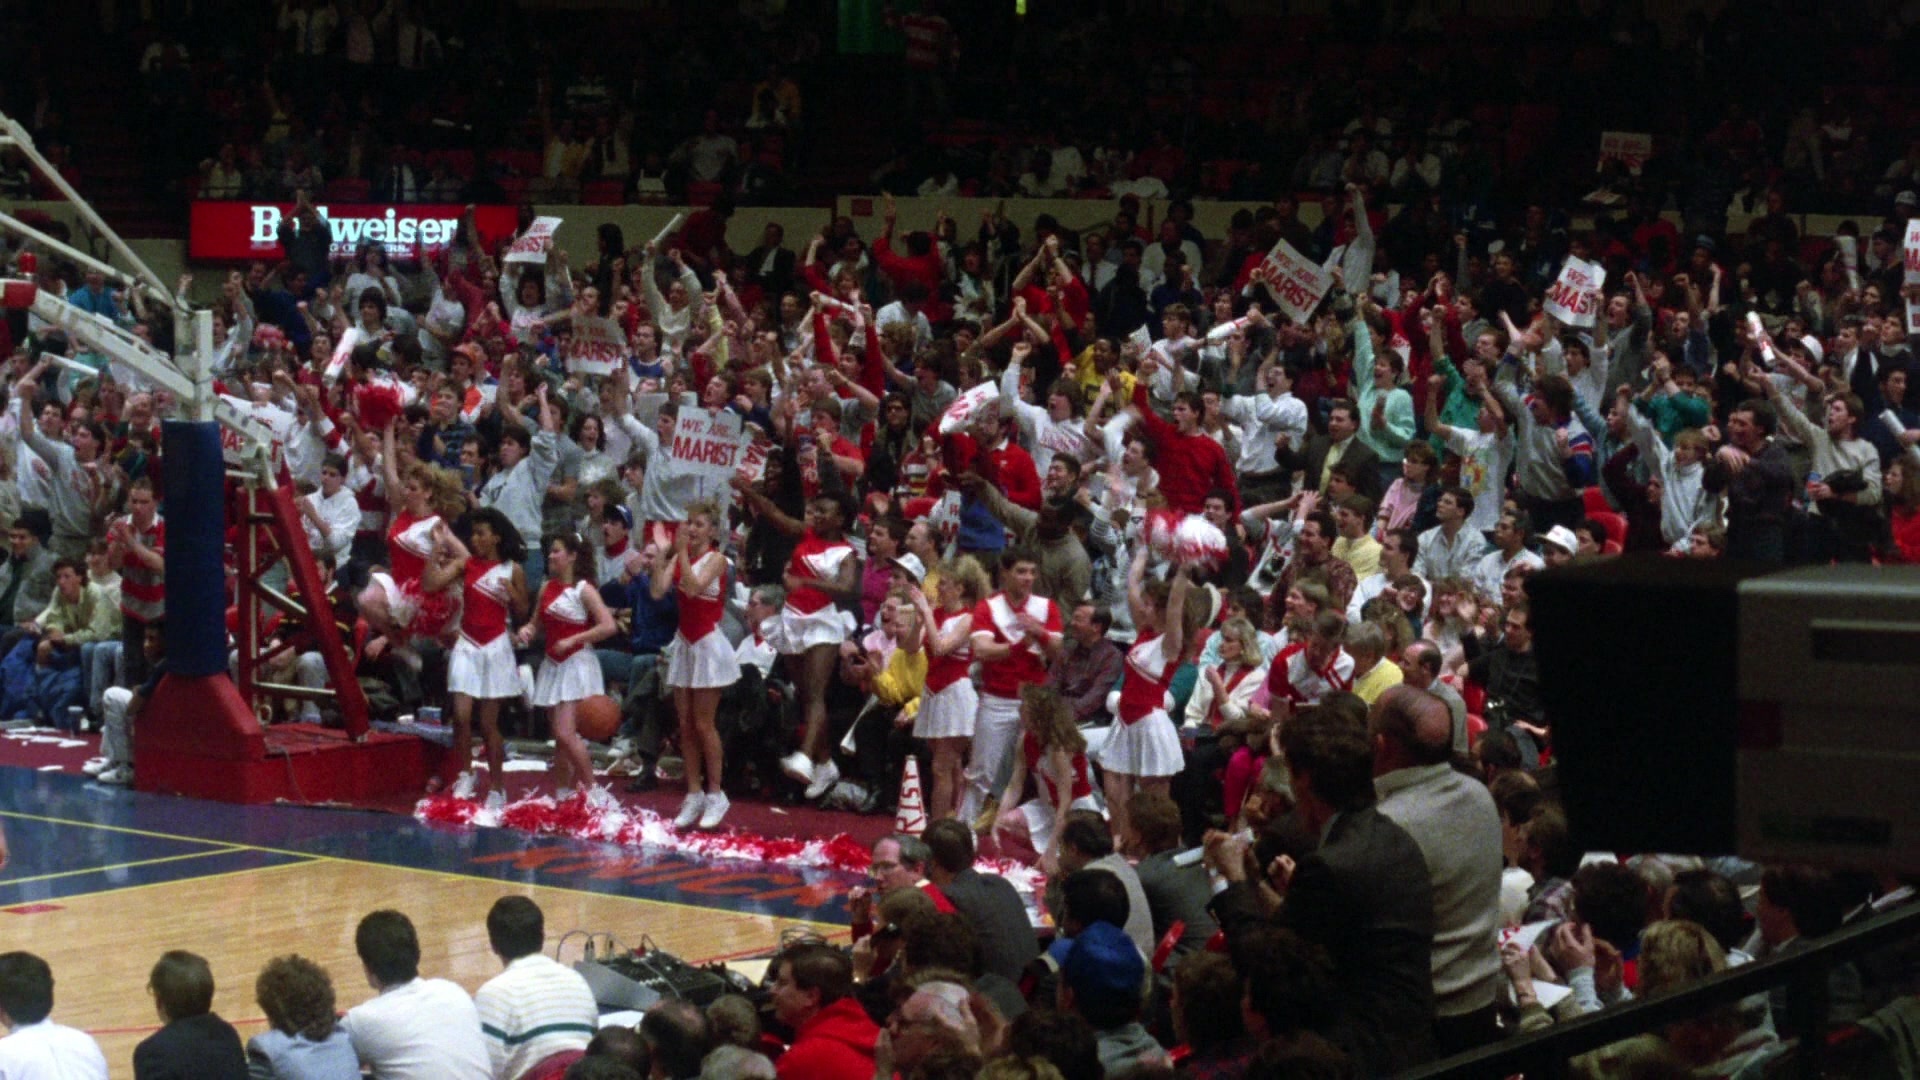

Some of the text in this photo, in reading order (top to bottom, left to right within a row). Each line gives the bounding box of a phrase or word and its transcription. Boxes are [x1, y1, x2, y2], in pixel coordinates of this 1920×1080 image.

[1261, 258, 1320, 312] MARIST
[682, 418, 705, 432] WE
[672, 435, 739, 467] MARIST
